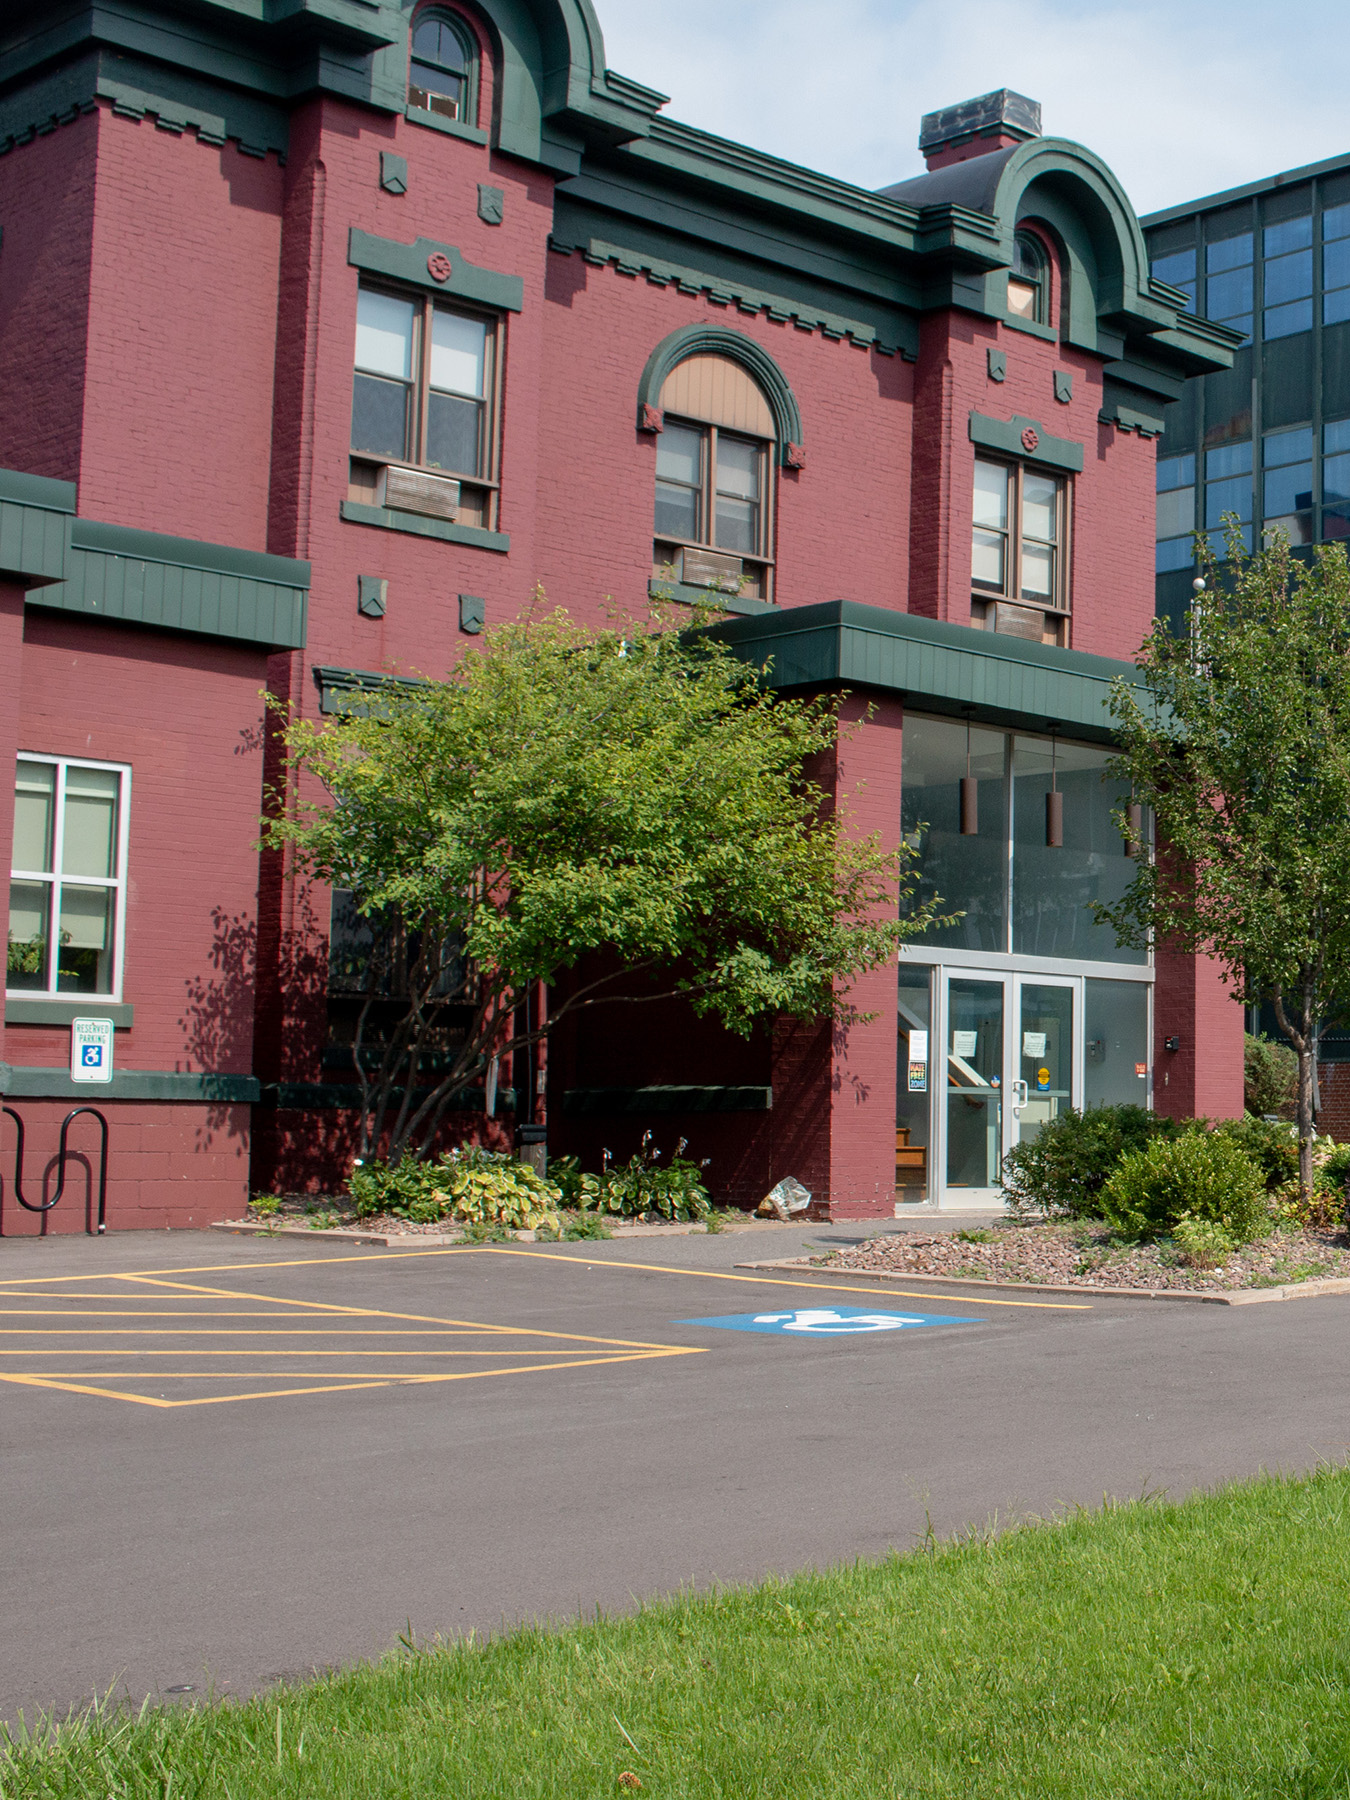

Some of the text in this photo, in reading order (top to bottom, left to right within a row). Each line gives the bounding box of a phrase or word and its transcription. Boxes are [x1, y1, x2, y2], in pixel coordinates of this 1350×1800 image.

[76, 1024, 109, 1034] RESERVED
[79, 1034, 106, 1044] PARKING
[910, 1071, 925, 1080] FREE
